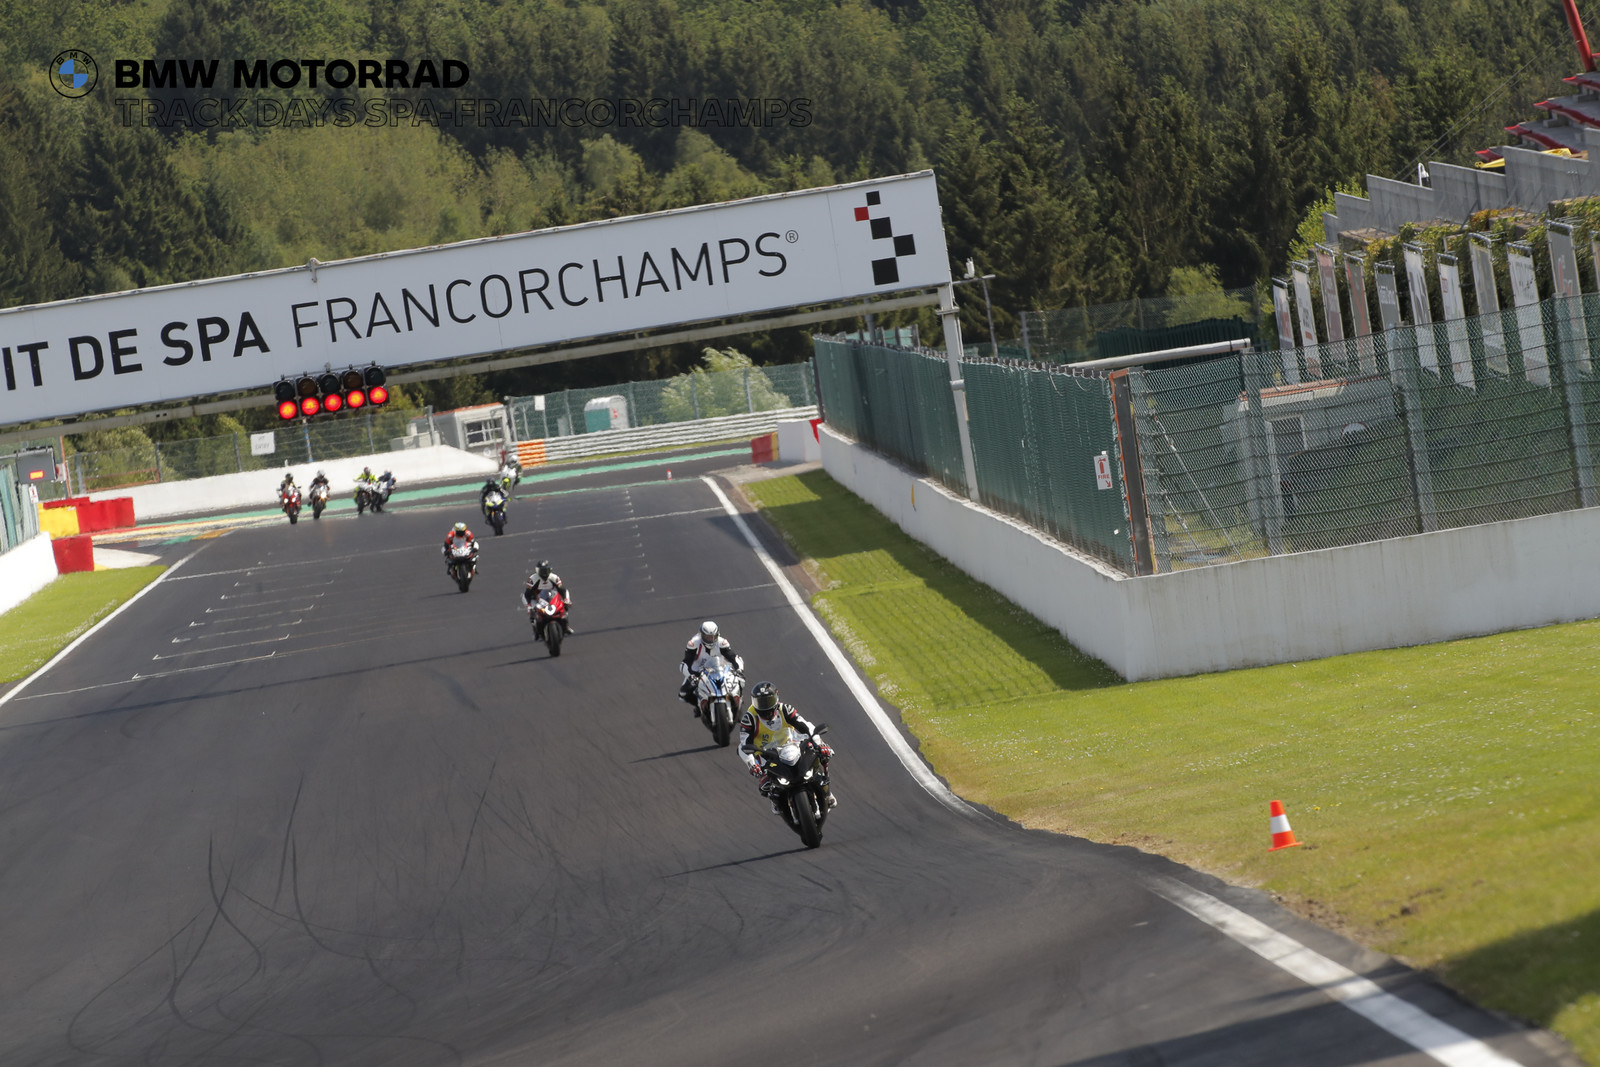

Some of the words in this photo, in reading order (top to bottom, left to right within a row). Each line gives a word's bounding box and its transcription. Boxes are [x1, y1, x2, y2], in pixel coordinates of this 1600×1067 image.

[2, 341, 49, 391] IT
[68, 328, 143, 382] DE
[161, 312, 271, 367] SPA
